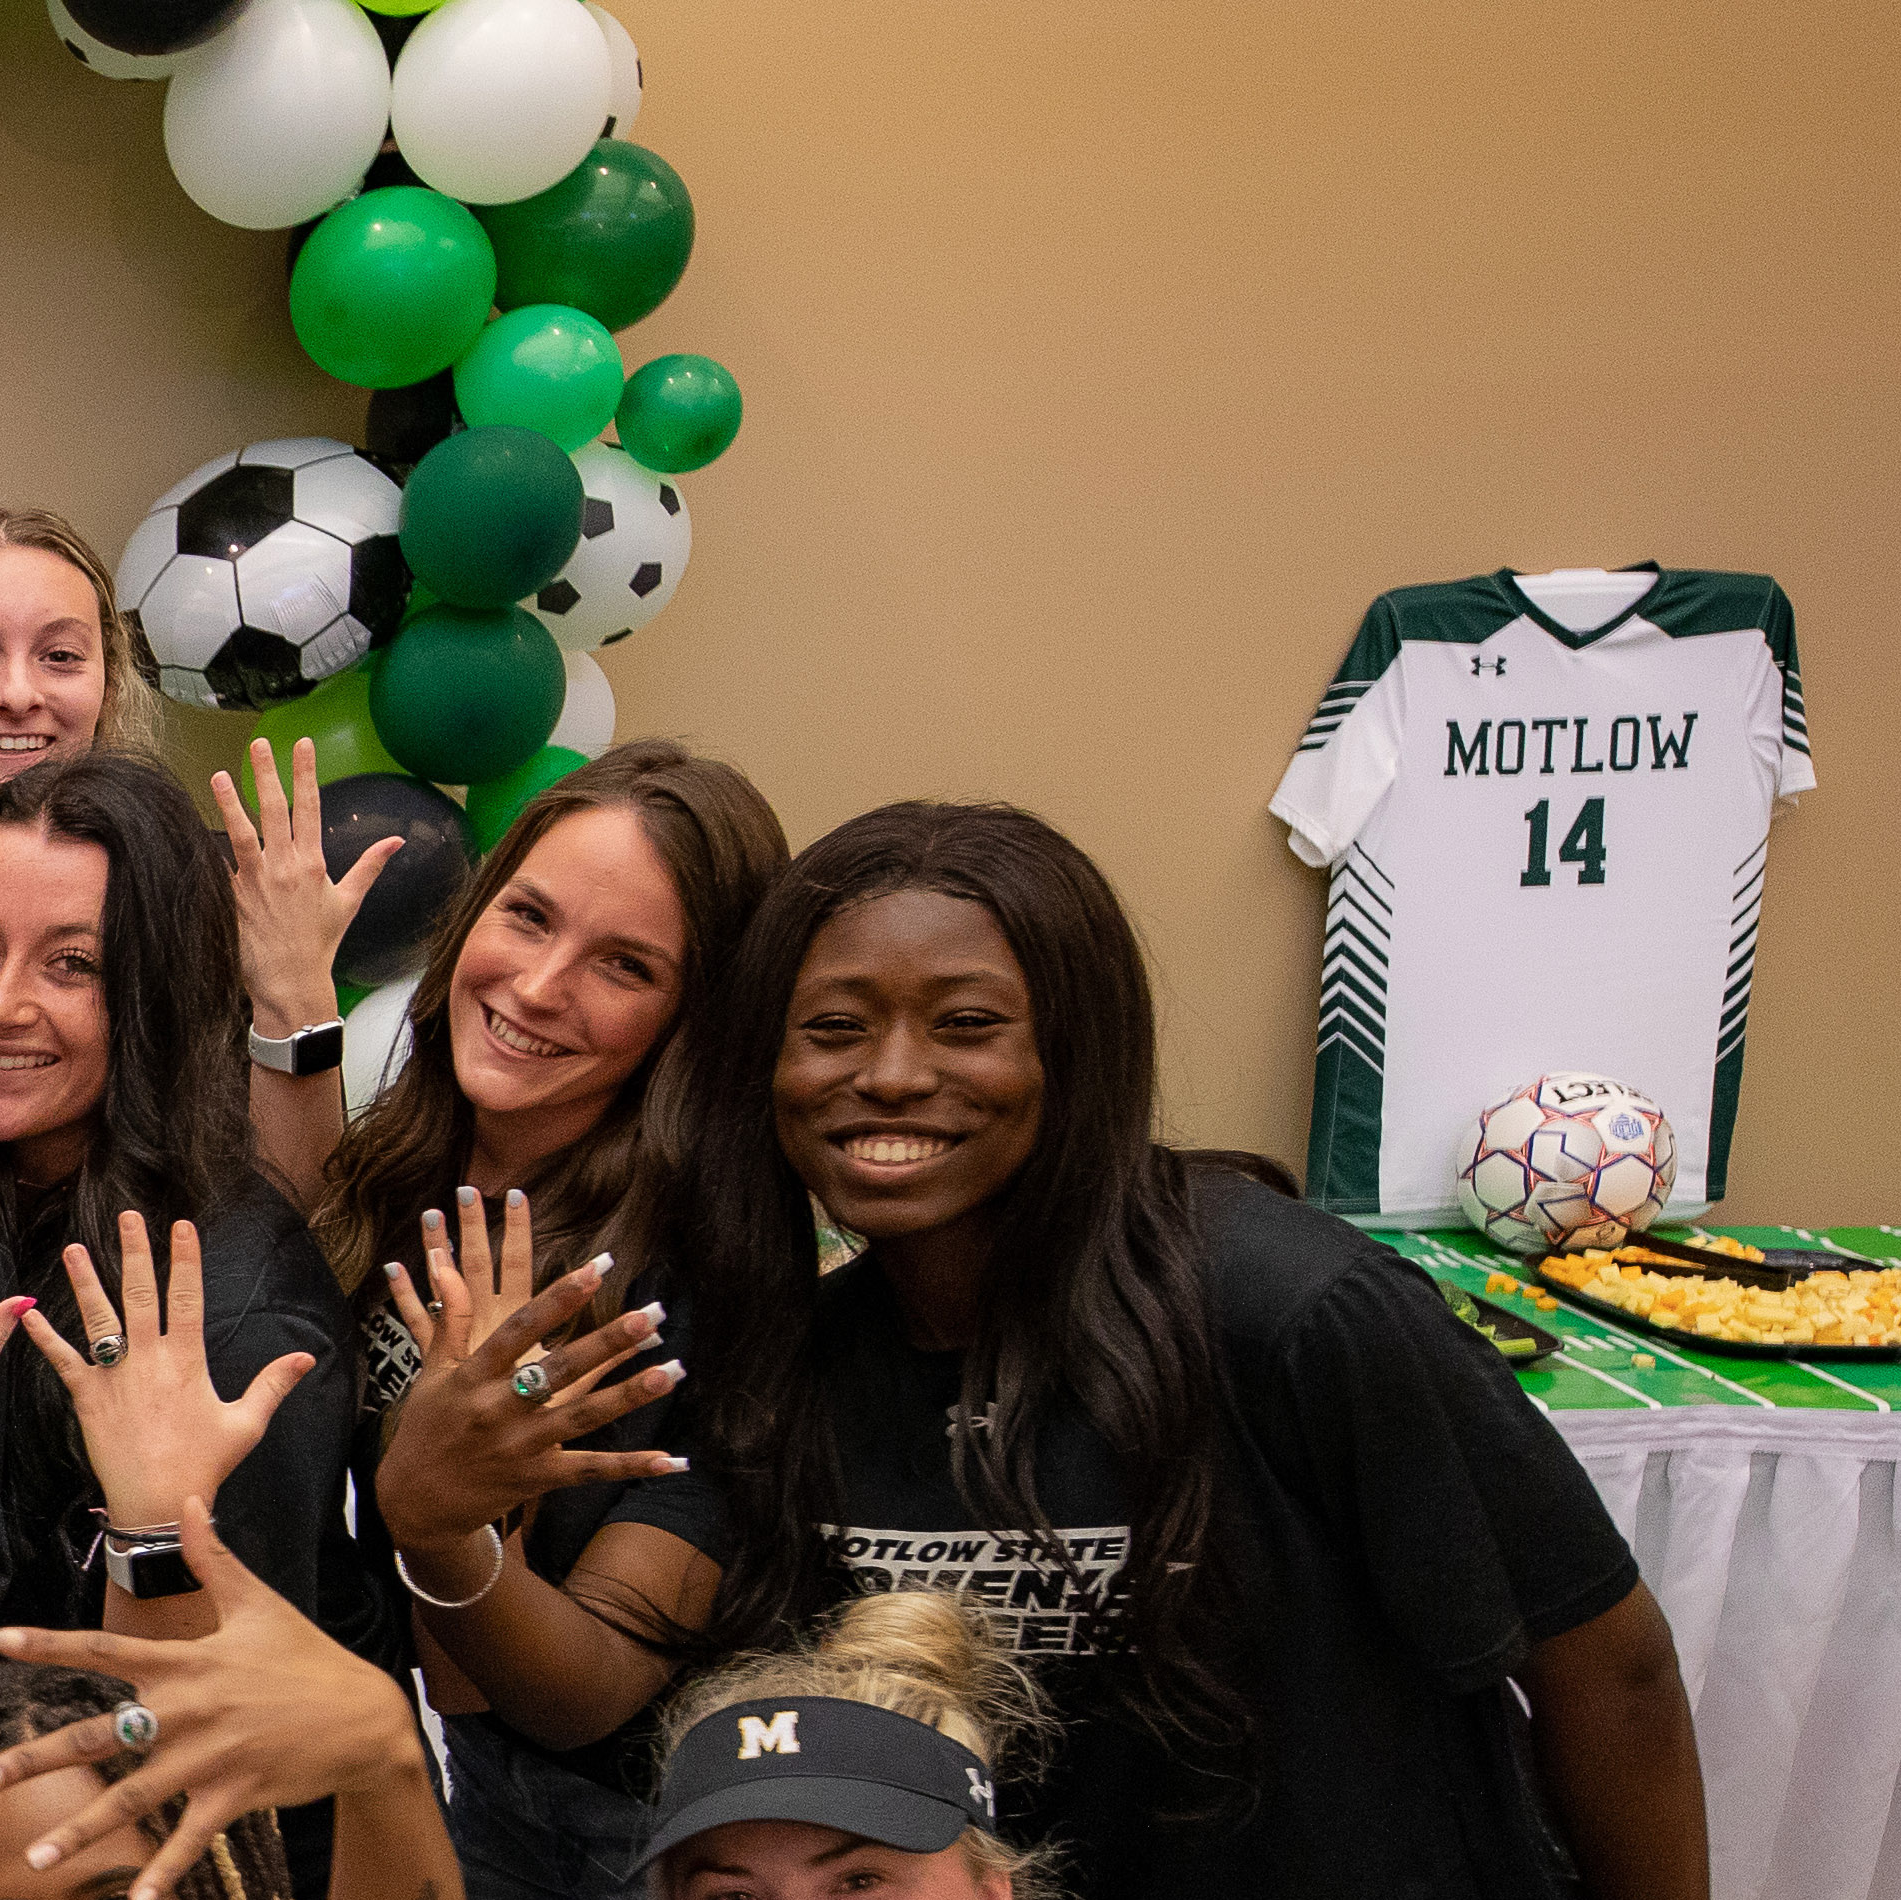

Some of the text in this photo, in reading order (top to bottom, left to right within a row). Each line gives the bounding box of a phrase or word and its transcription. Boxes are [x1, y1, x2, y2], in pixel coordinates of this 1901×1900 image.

[1444, 711, 1698, 777] MOTLOW
[1520, 796, 1607, 888] 14
[837, 1536, 990, 1563] OTLOW
[738, 1711, 800, 1760] M
